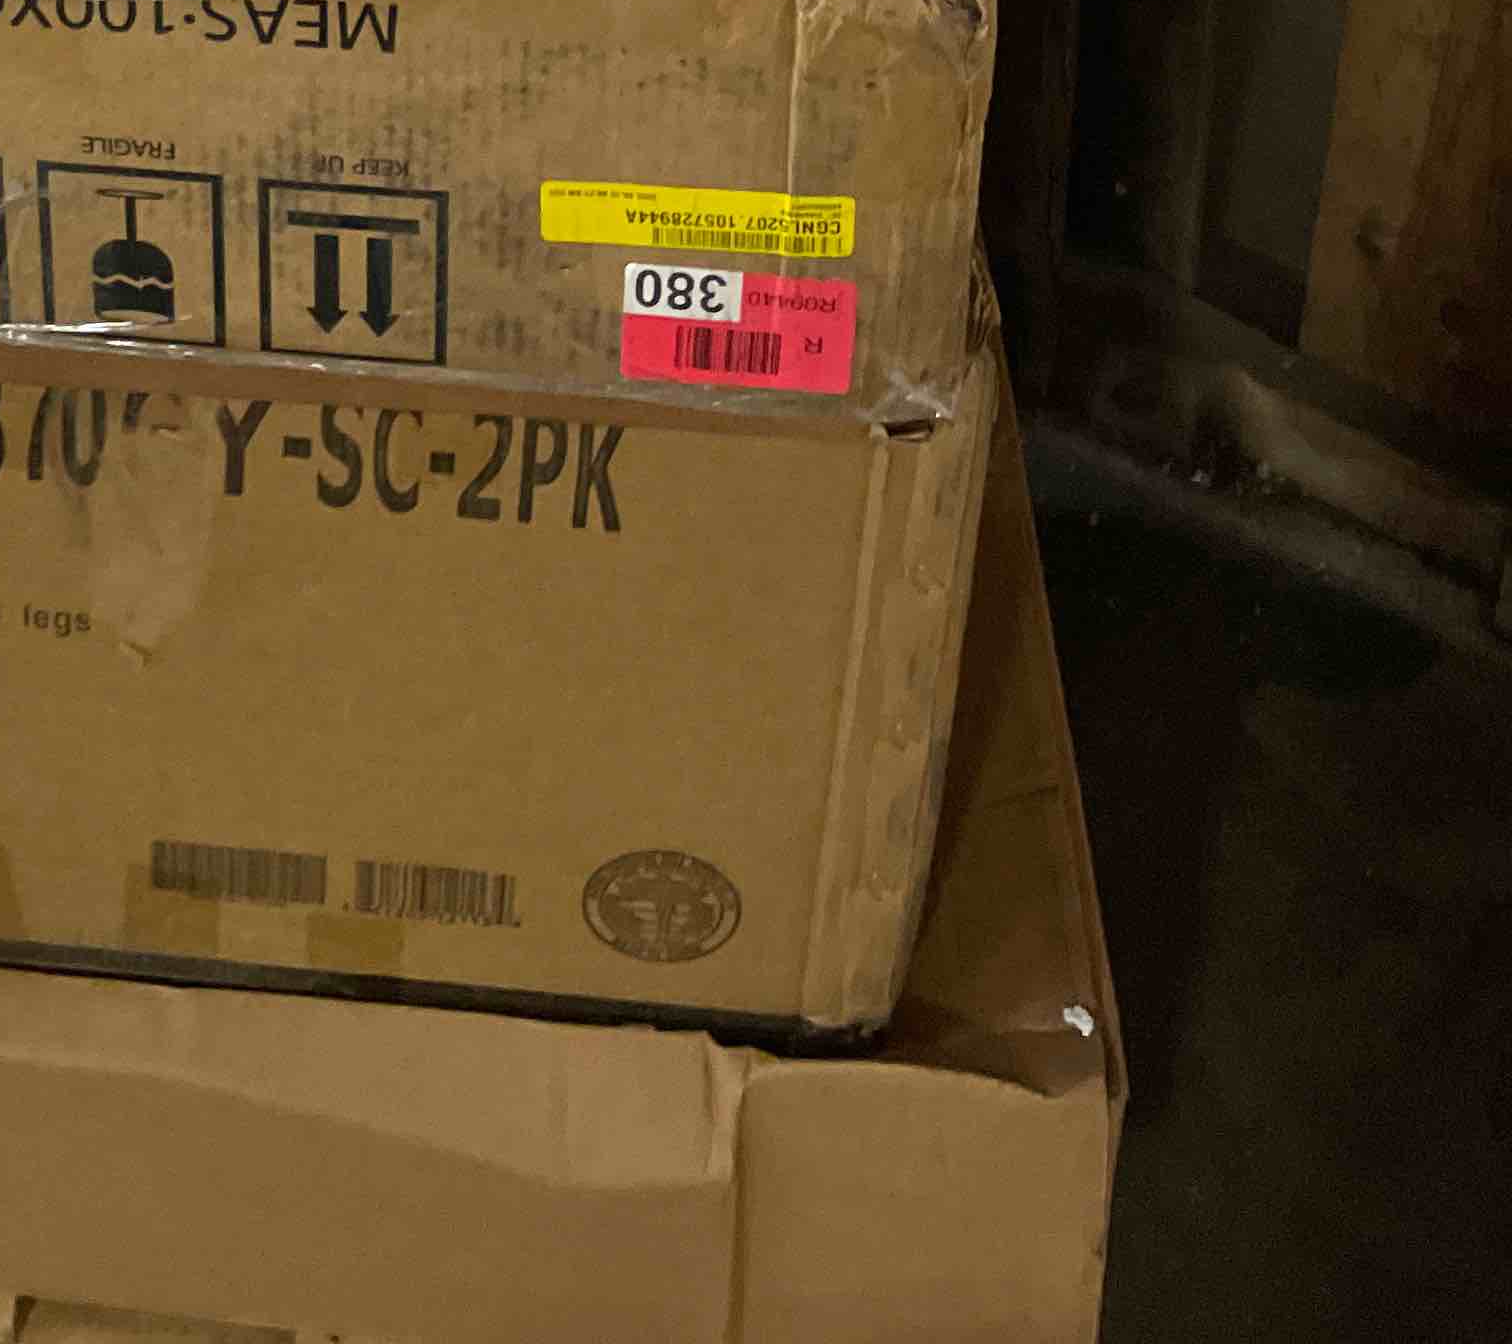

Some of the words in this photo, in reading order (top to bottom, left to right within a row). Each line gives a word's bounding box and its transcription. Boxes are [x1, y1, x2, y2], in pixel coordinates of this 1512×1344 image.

[82, 135, 176, 161] FRAGILE
[311, 153, 345, 175] UP
[352, 156, 410, 178] KEEP
[634, 268, 728, 314] 380
[803, 335, 824, 355] R
[22, 602, 94, 639] legs
